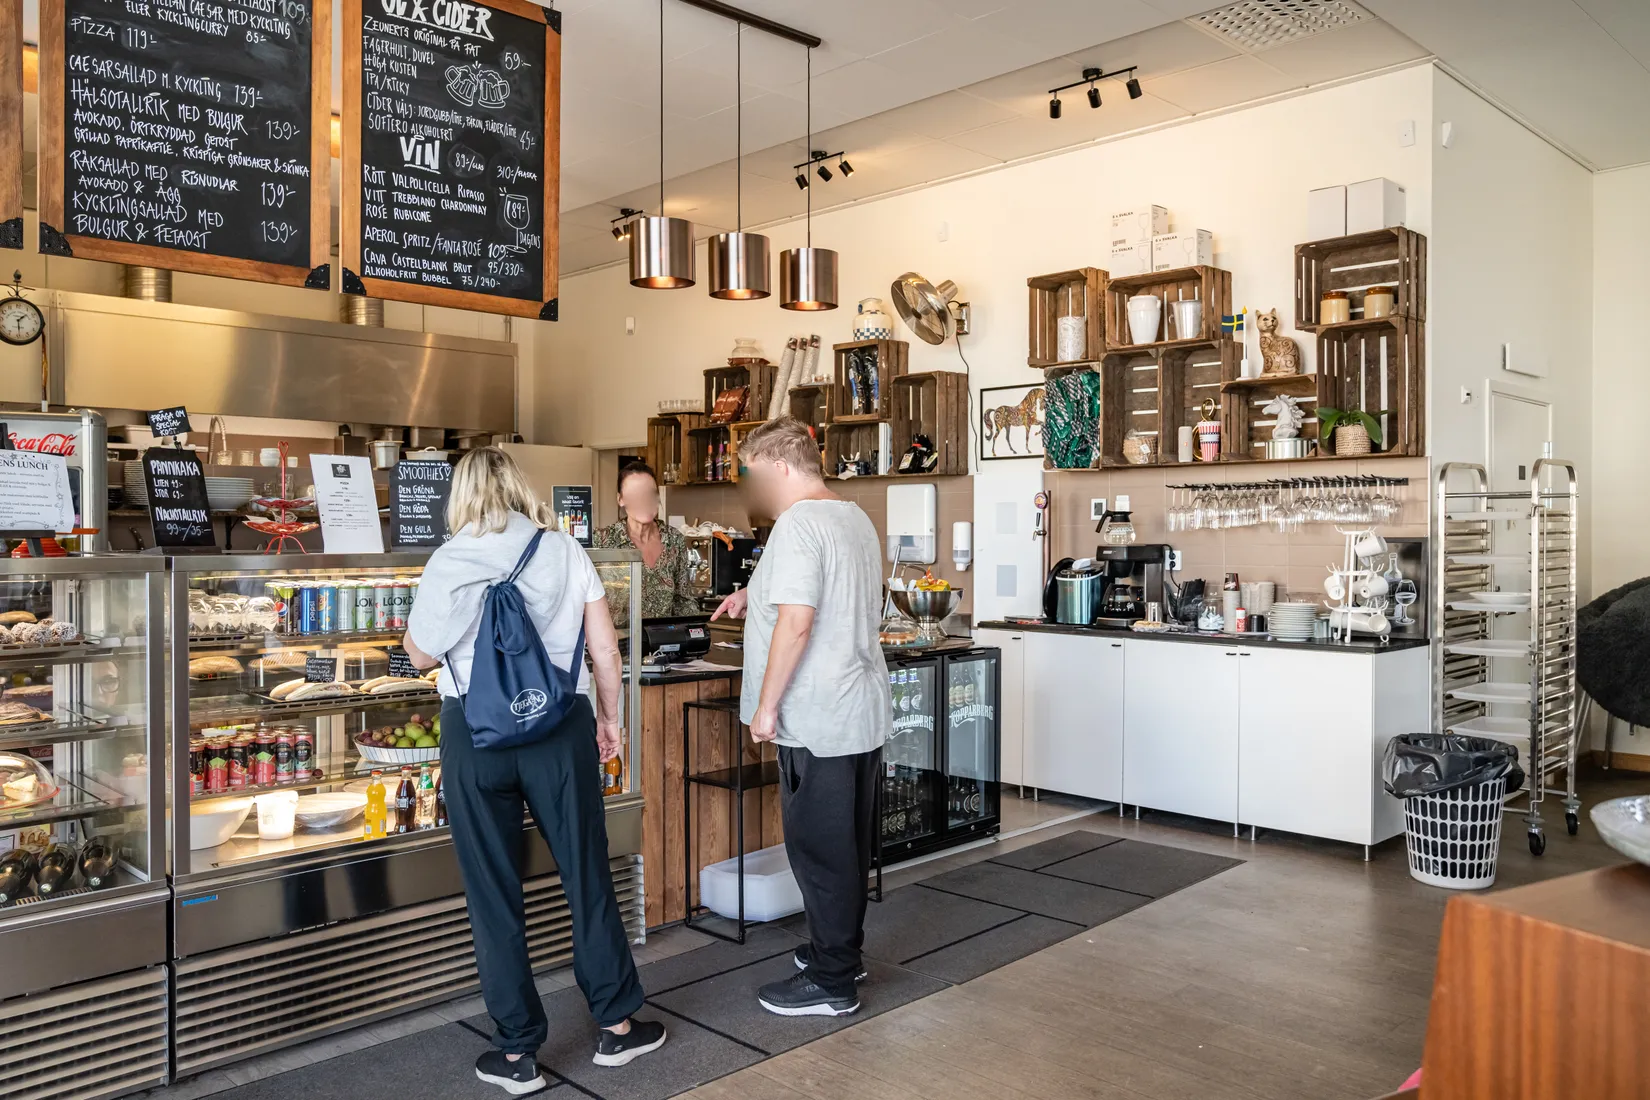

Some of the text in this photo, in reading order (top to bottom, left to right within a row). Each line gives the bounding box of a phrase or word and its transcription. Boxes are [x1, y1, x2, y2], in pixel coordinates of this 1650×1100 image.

[71, 16, 115, 41] PIZZA
[125, 0, 151, 17] ELLER
[157, 8, 229, 37] KYCKLINGCURRY
[190, 0, 225, 23] CAESAR
[228, 8, 248, 25] MED
[250, 14, 291, 40] KYCKLING
[433, 0, 494, 40] CIDER
[363, 14, 481, 57] ZEUNERTS ORIGINAL PÅ FAT
[363, 53, 417, 79] HÖGA KUSTEN
[412, 47, 435, 65] DUVEL
[175, 75, 221, 102] KYCKLING
[71, 78, 170, 121] HÄLSOTALLRIK
[178, 104, 200, 123] MED
[205, 109, 248, 136] BULGUR
[366, 91, 393, 113] CIDER
[131, 115, 196, 144] ÖRTKRYDDAD
[205, 133, 238, 150] GETOST
[368, 112, 407, 134] SOFIERO
[74, 127, 110, 145] GRILLAD
[183, 145, 225, 164] KRISPIGA
[228, 152, 273, 172] GRÖNSAKER
[282, 159, 310, 178] SKINKA
[70, 150, 139, 179] RÄKSALLAD
[145, 164, 168, 180] MED
[181, 170, 240, 191] RISNUDLAR
[363, 164, 485, 202] RÖTT VALPOLICELLA RIPASSO
[78, 175, 181, 206] AVOKADO & ÄGG
[364, 187, 487, 216] VITT TREBBIANO CHARDONNAY
[73, 190, 224, 230] KYCKLINGSALLAD MED
[365, 204, 388, 219] ROSÉ
[393, 207, 432, 222] RUBICONE
[73, 214, 132, 241] BULGUR
[135, 223, 149, 242] &
[153, 224, 212, 249] FETAOST
[364, 224, 400, 245] APEROL
[364, 247, 387, 266] CAVA
[392, 252, 448, 272] CASTELLBLANK
[453, 262, 473, 274] BRUT
[364, 264, 418, 279] ALKOHOLFRITT
[422, 272, 452, 285] BUBBEL
[17, 460, 48, 470] LUNCH
[150, 460, 200, 476] PANNKAKA
[398, 484, 435, 494] DEN GRÖNA
[155, 506, 208, 522] NACHOTALLRIK
[399, 504, 411, 513] DEN
[400, 525, 432, 533] DEN GULA
[950, 704, 994, 729] KOPPARBERG
